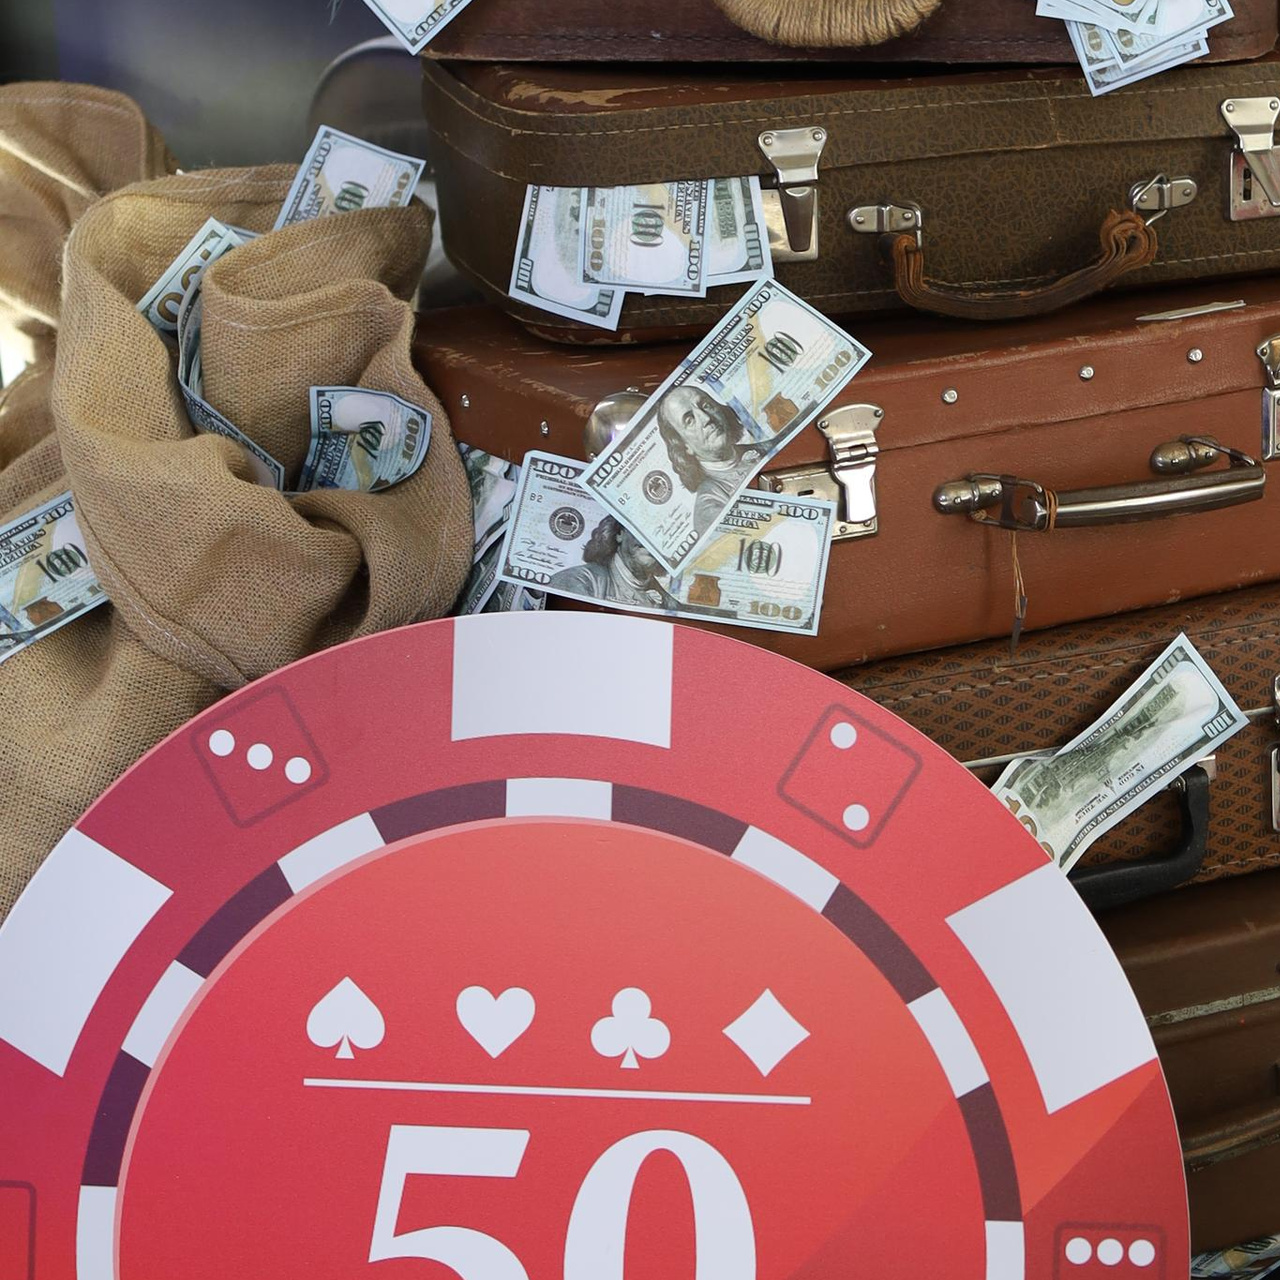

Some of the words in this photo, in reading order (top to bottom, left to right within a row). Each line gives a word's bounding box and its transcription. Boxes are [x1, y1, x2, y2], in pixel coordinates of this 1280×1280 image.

[413, 2, 447, 37] 100
[629, 203, 664, 249] 100
[590, 219, 605, 272] 100
[687, 239, 700, 281] 100
[515, 257, 533, 289] 100
[741, 288, 772, 319] 100
[755, 328, 806, 376] 100
[812, 348, 854, 391] 100
[316, 397, 335, 429] 100
[396, 416, 424, 460] 100
[534, 461, 576, 479] 100
[588, 449, 625, 487] 100
[530, 493, 543, 503] B2
[617, 492, 631, 506] B2
[777, 503, 818, 522] 100
[668, 528, 702, 564] 100
[735, 536, 782, 579] 100
[510, 567, 551, 584] 100
[746, 597, 803, 623] 100
[1203, 712, 1233, 737] 100
